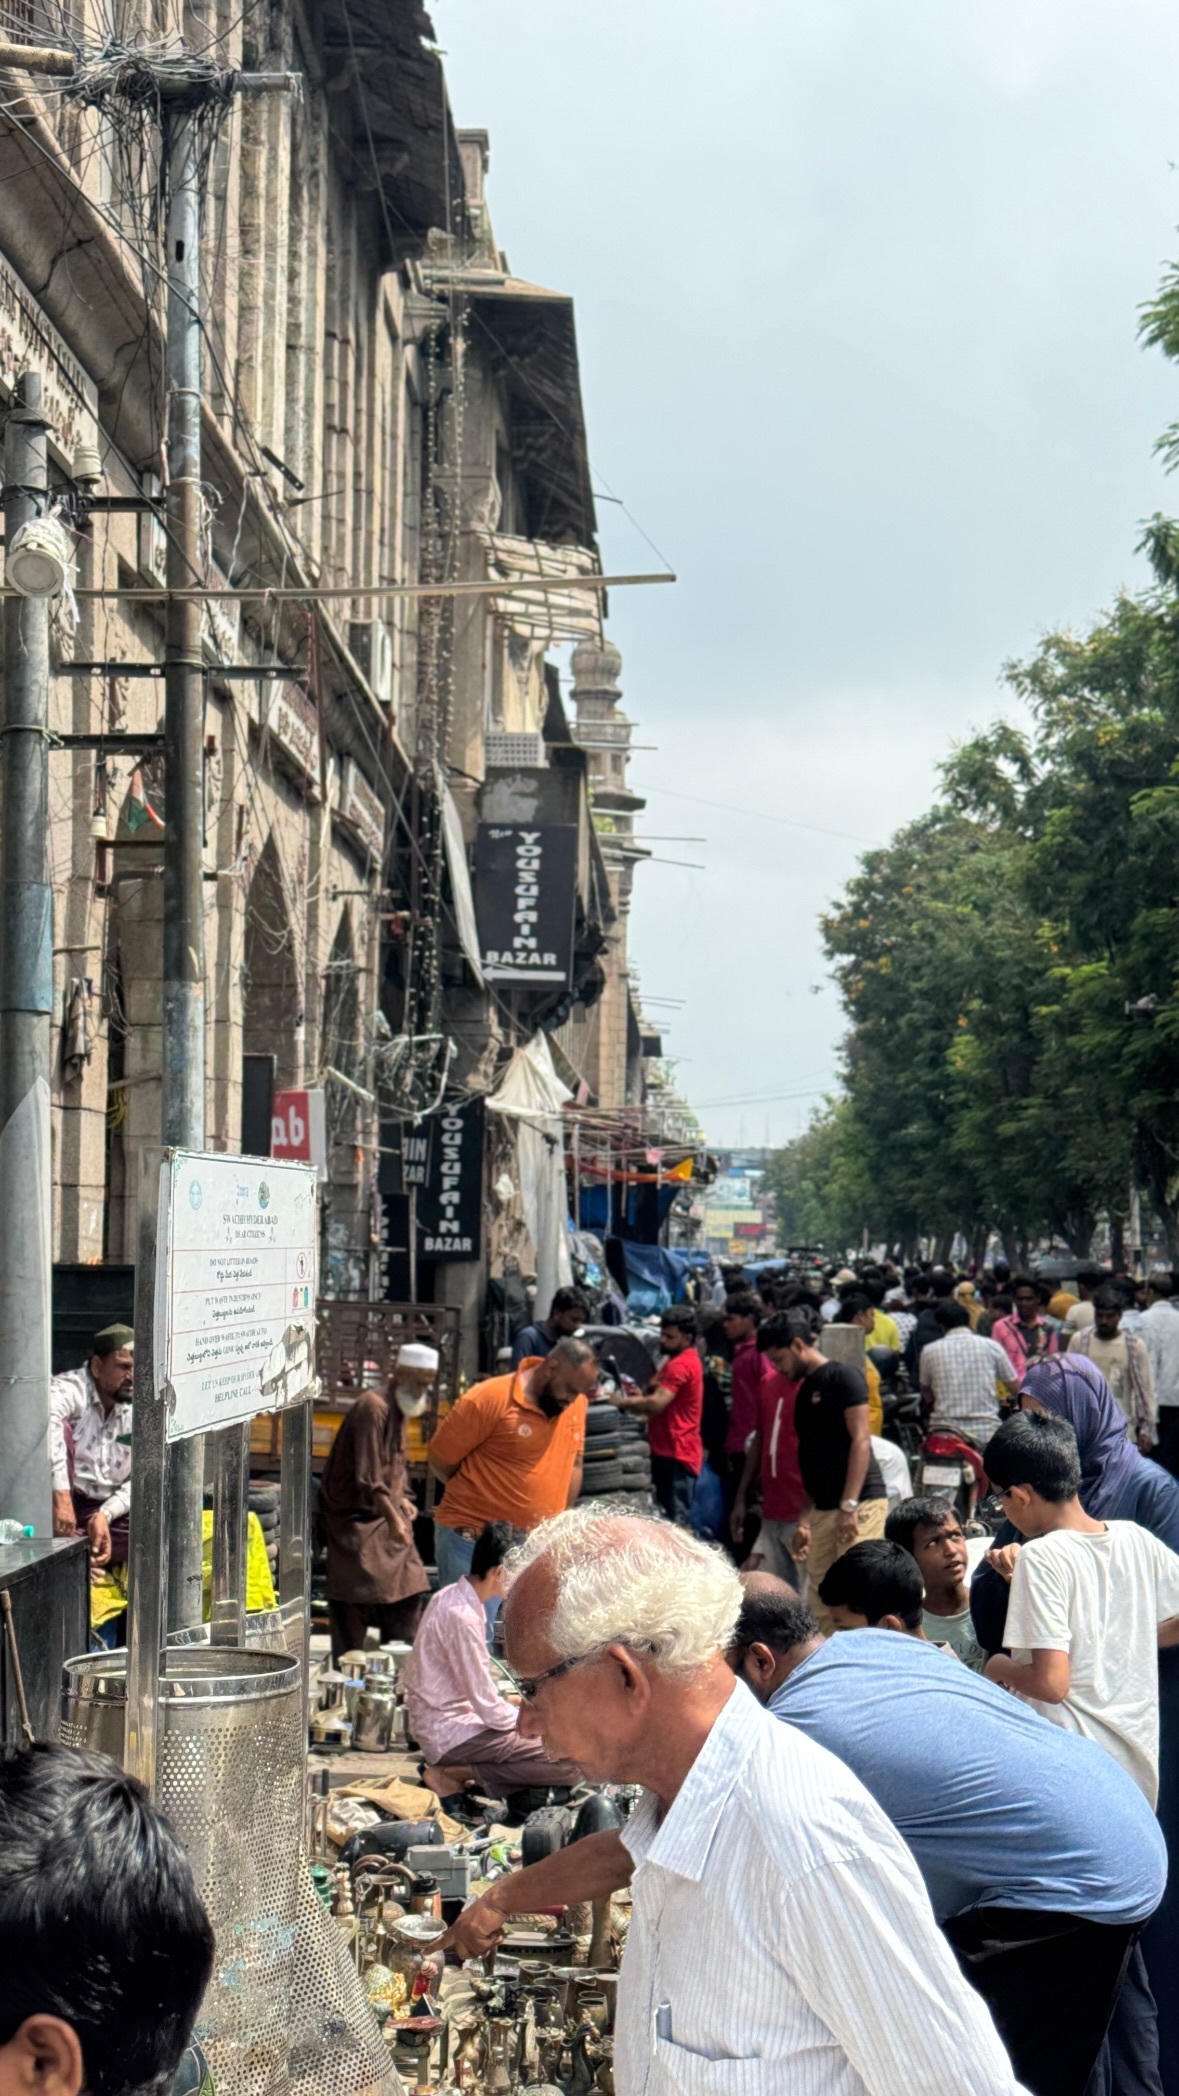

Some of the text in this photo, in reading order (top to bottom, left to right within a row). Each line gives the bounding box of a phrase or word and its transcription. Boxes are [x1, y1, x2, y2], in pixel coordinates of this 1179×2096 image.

[513, 831, 542, 949] YOUSUFAIN
[486, 951, 557, 965] BAZAR
[439, 1103, 464, 1234] YOUSUFAIN
[246, 1214, 278, 1225] HYDERABAD
[424, 1237, 472, 1252] BAZAR
[217, 1258, 226, 1266] NOT
[195, 1336, 208, 1346] HAND
[209, 1335, 220, 1345] OVER
[202, 1380, 212, 1391] LET
[215, 1385, 251, 1403] HELPLINE CALL
